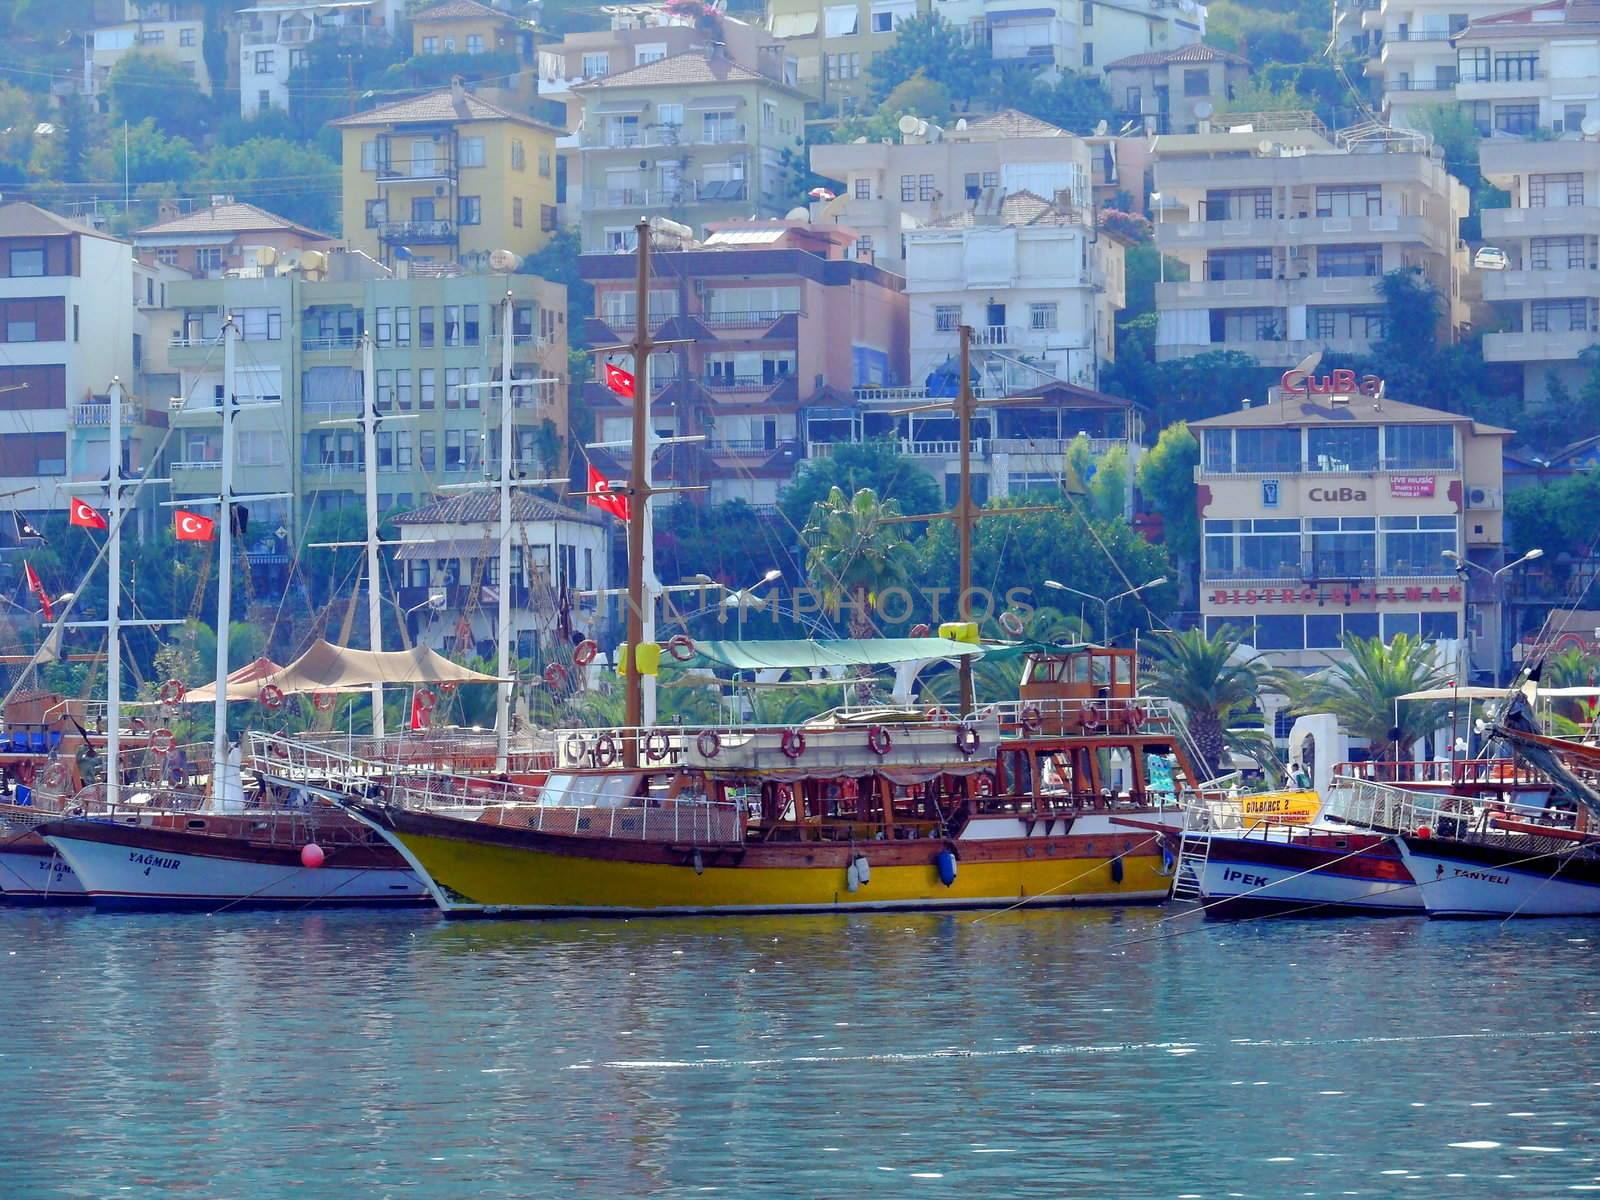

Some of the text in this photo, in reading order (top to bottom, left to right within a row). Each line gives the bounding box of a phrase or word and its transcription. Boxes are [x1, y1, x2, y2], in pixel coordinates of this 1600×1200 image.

[1281, 368, 1381, 396] CuBa
[1308, 487, 1367, 502] CuBa
[1214, 588, 1316, 605] BISTRO
[1284, 799, 1290, 810] 2
[129, 852, 181, 870] YAĞMUR
[56, 873, 63, 882] 2
[144, 867, 151, 876] 4
